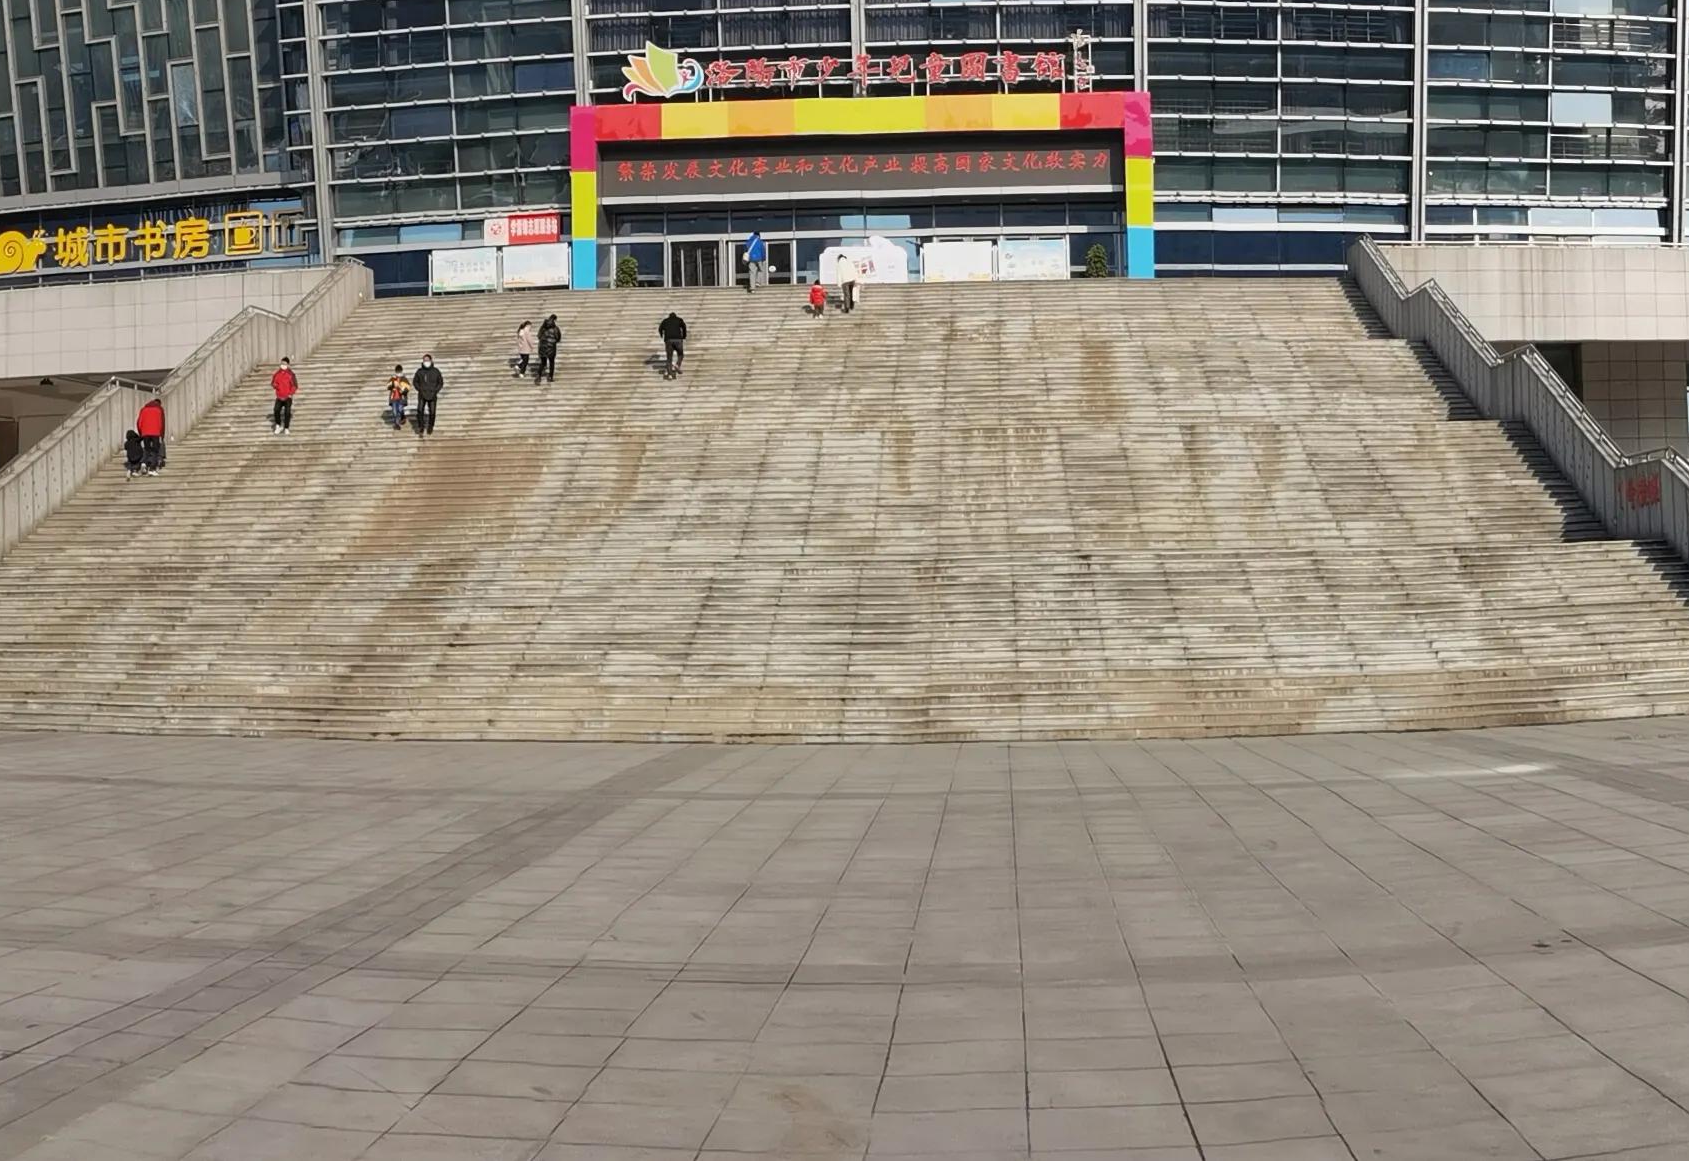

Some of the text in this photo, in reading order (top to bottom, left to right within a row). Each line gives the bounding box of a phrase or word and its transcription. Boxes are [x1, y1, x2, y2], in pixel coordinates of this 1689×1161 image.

[616, 151, 1108, 182] 繁荣发展文化事业和文化产业 提高国家文化软实力
[54, 217, 210, 268] 城市书房
